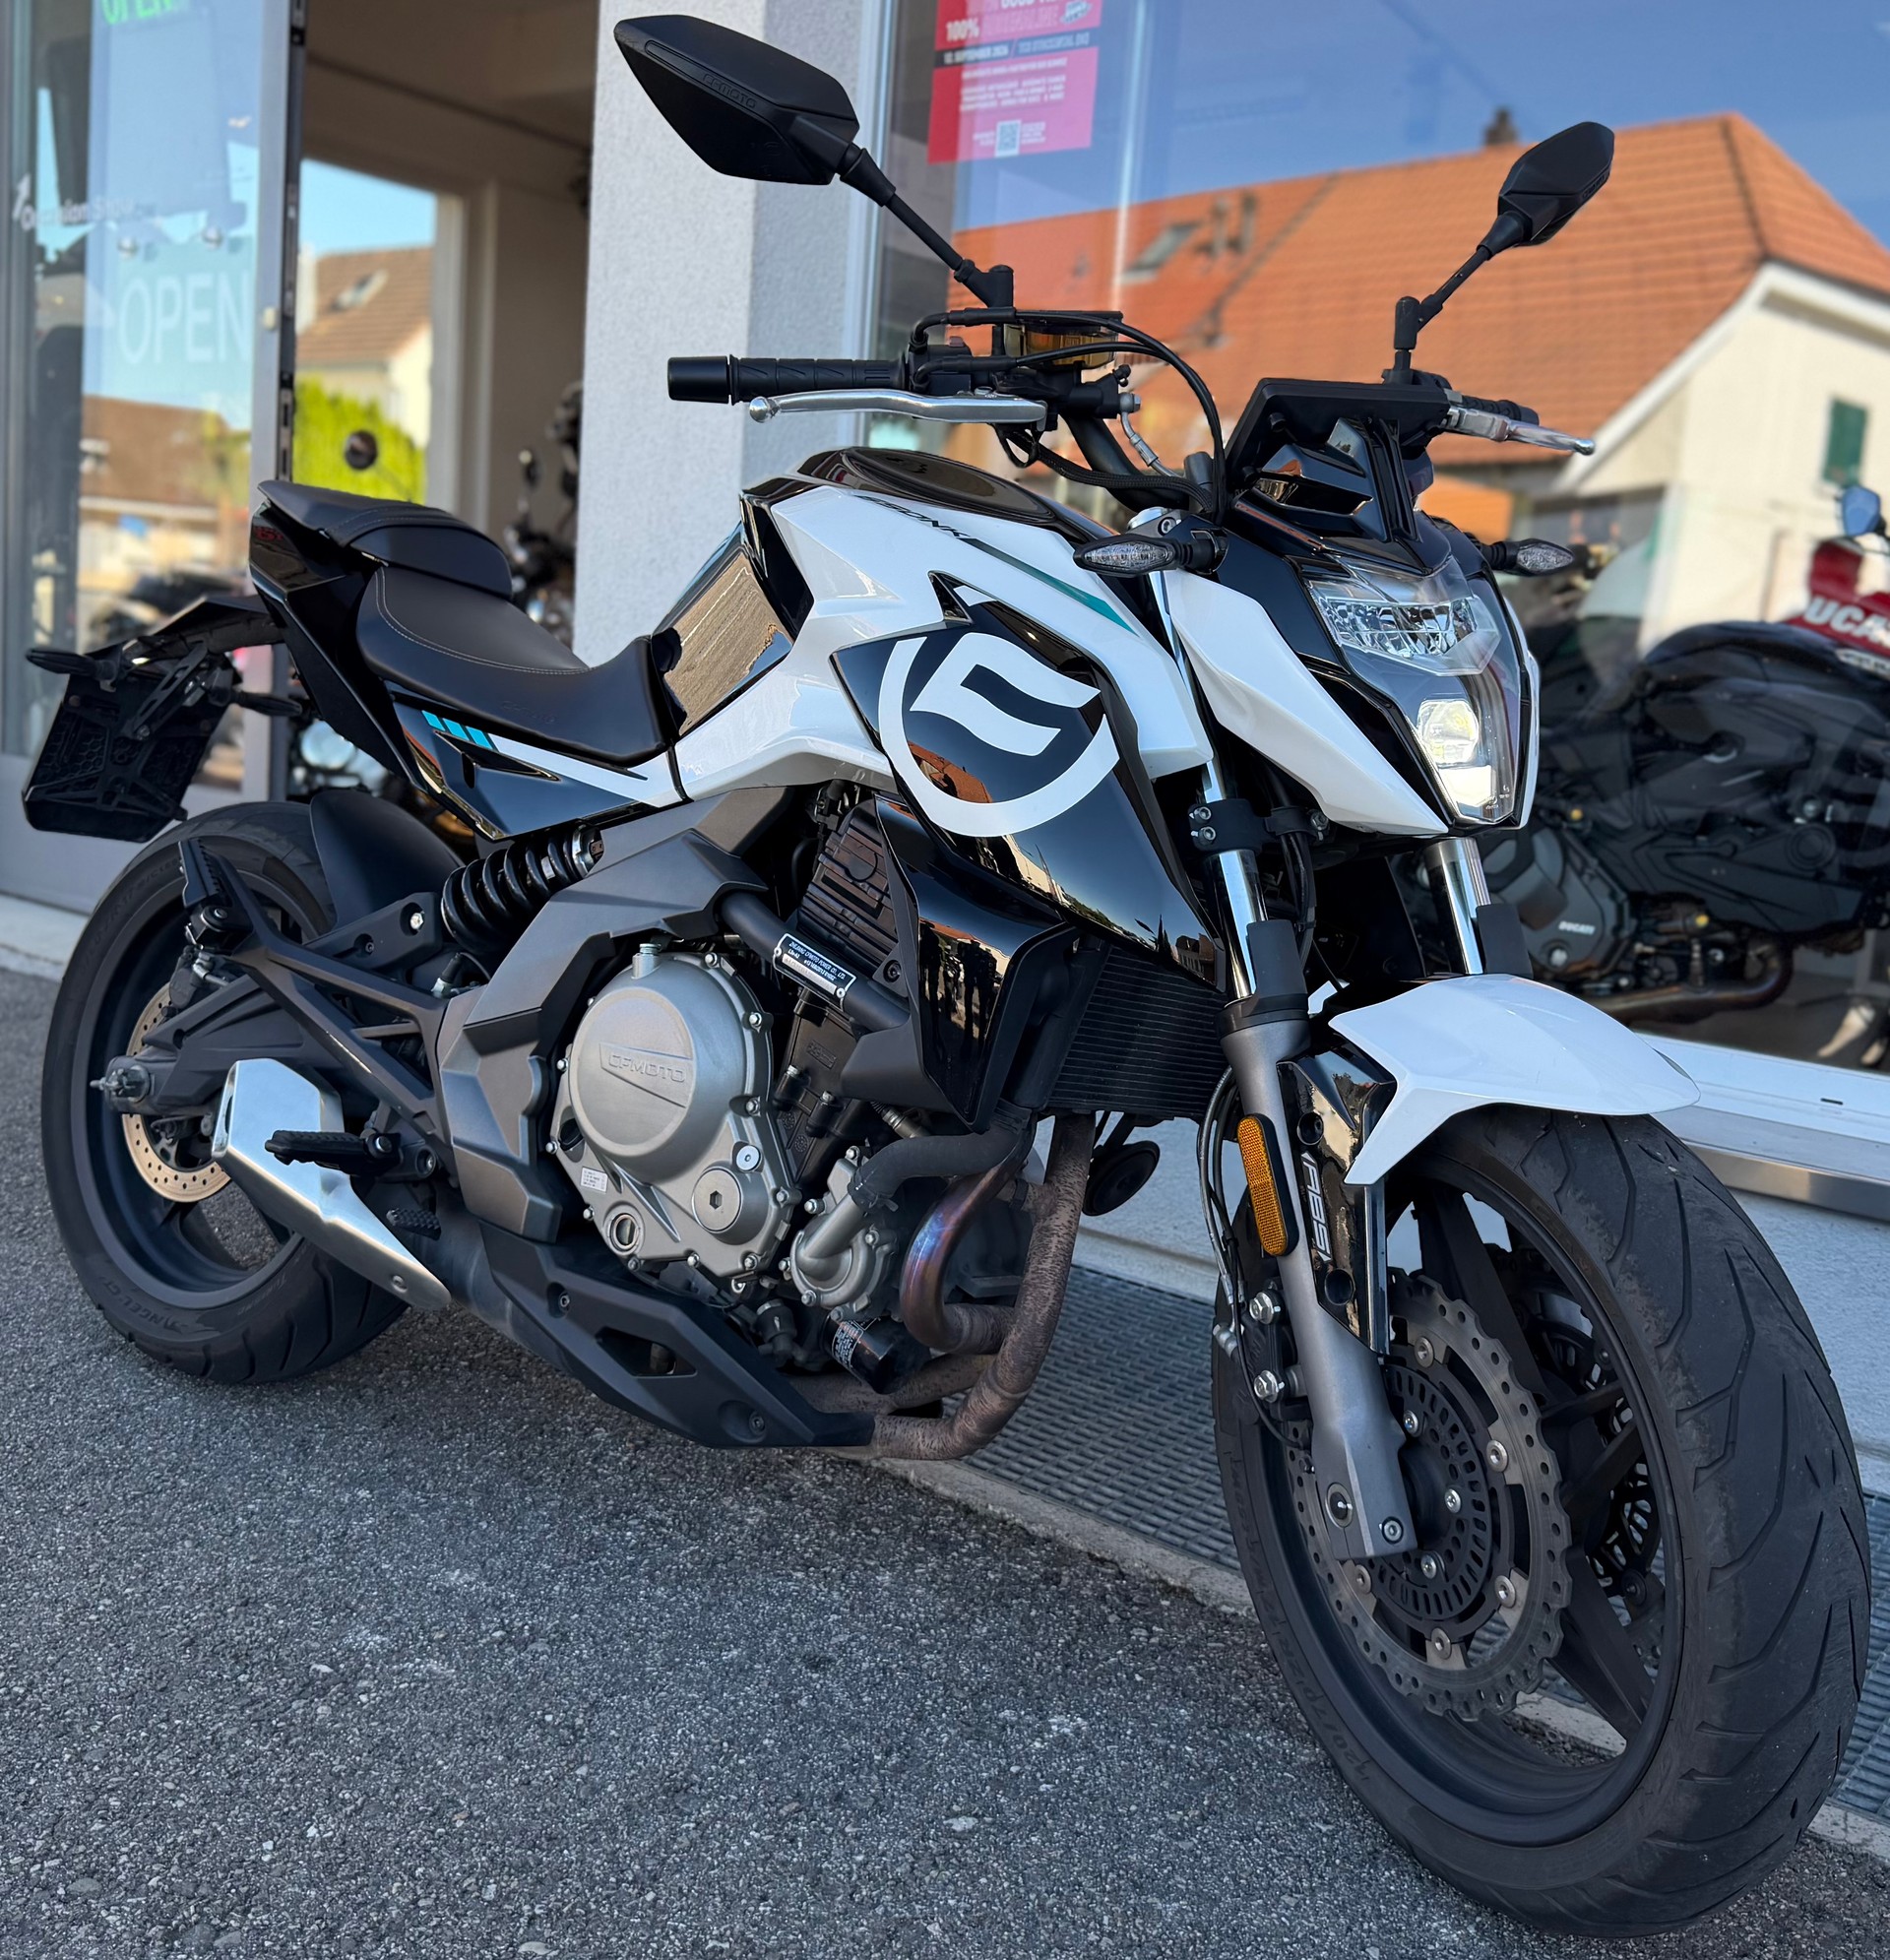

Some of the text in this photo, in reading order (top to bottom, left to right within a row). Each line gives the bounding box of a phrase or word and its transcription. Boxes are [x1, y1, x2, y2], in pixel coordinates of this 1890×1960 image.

[702, 73, 757, 109] CFMOTO
[119, 271, 250, 364] OPEN
[608, 1054, 685, 1083] CFMOTO
[1302, 1161, 1331, 1256] ABS
